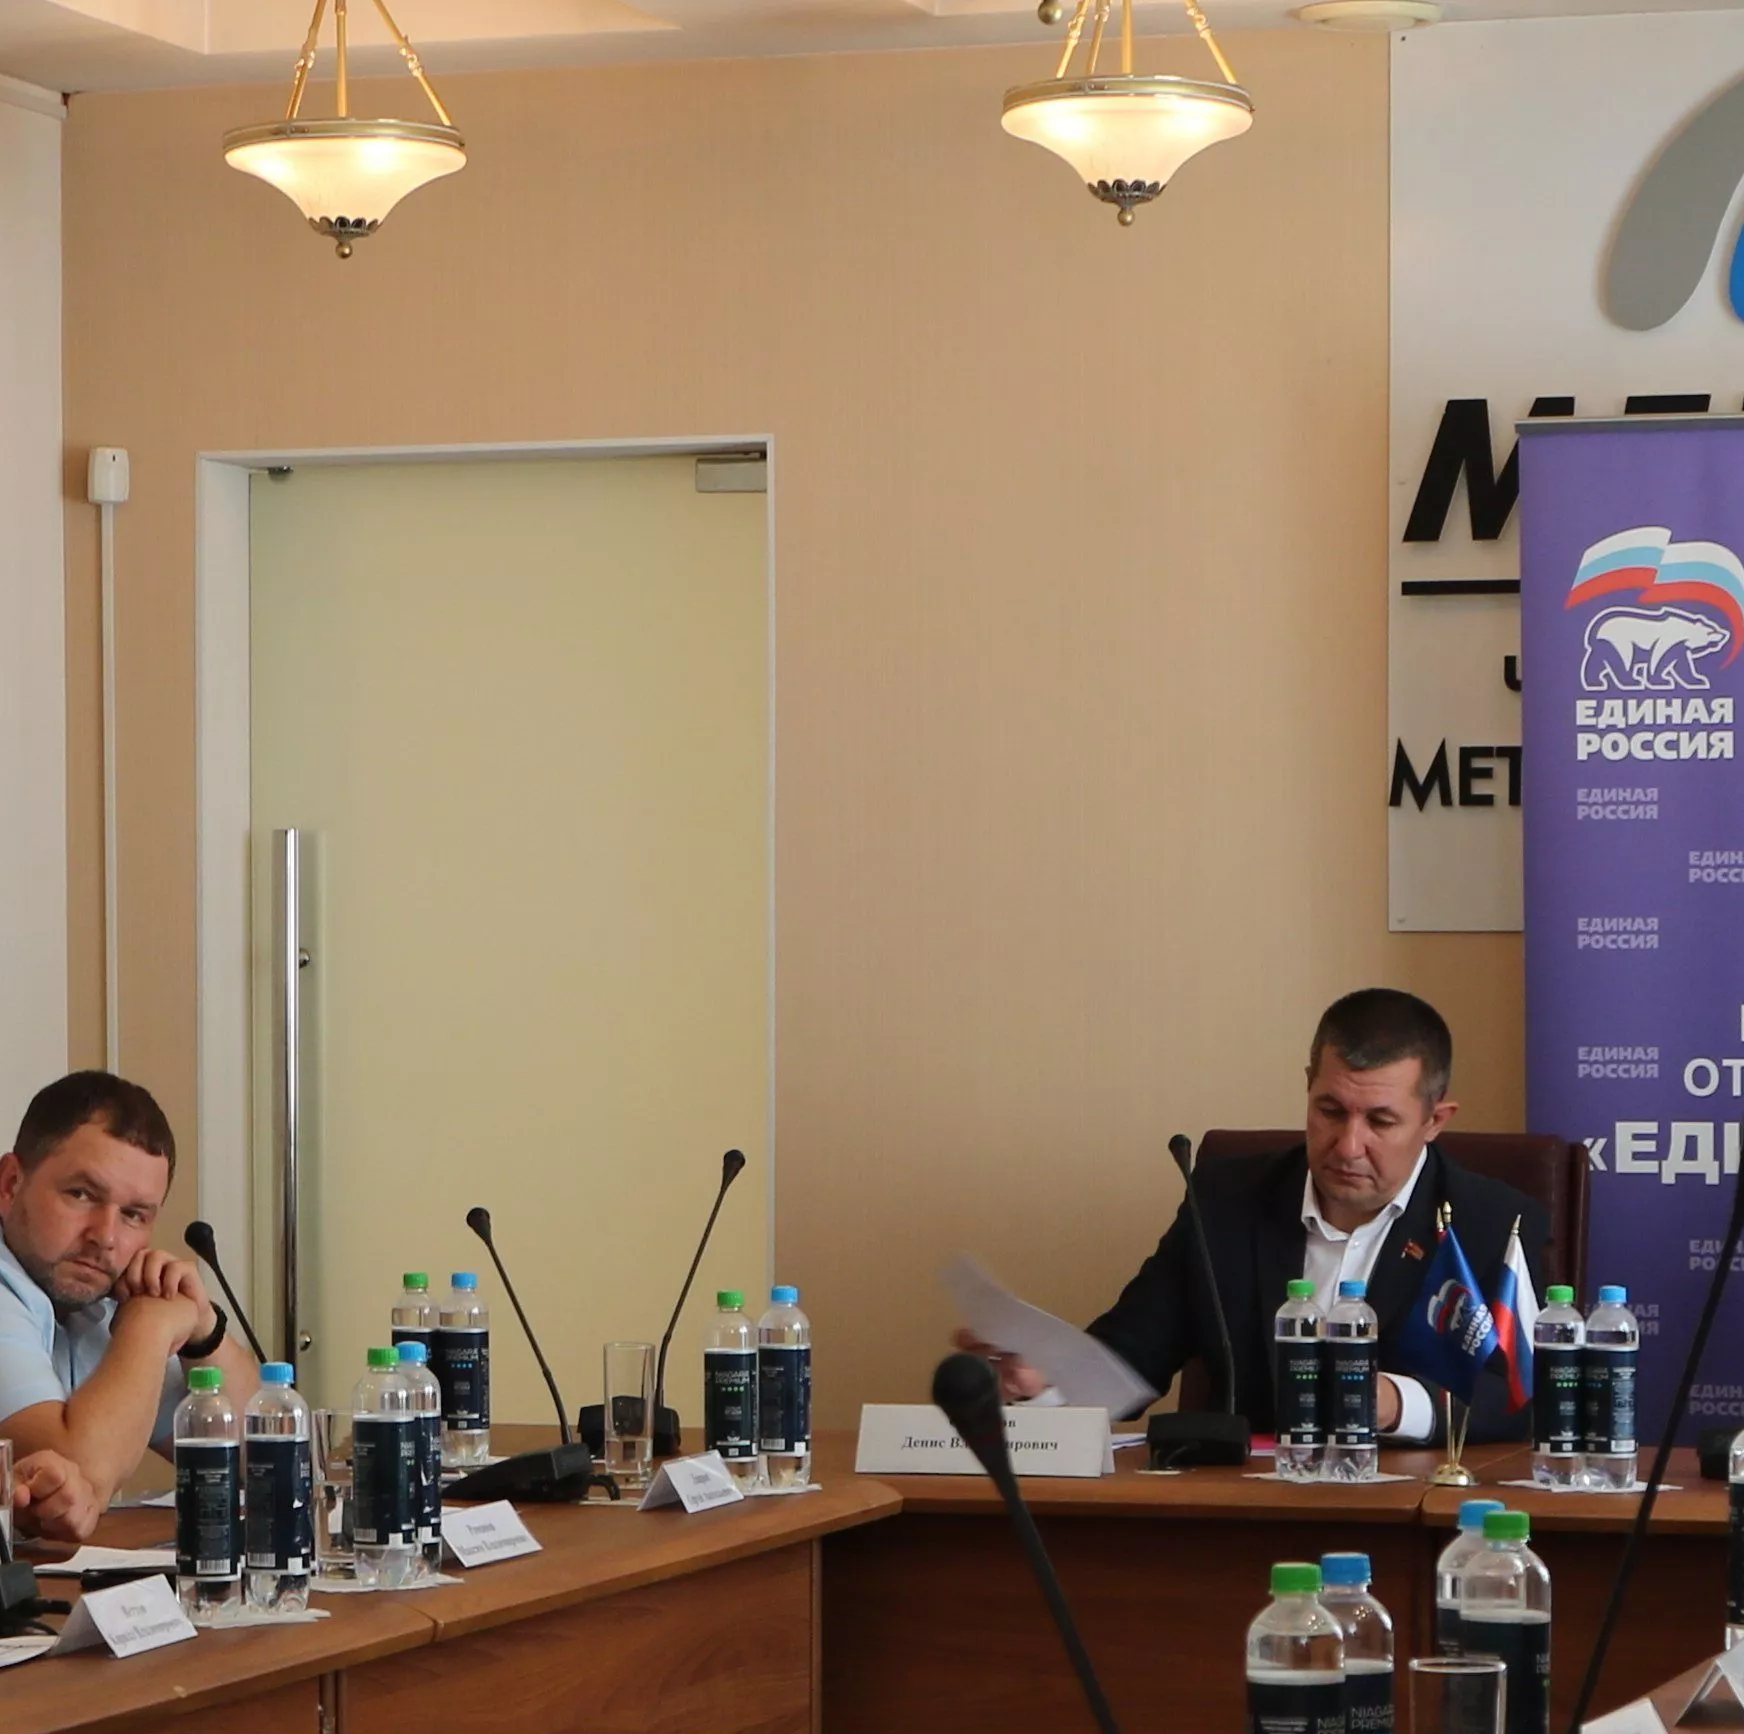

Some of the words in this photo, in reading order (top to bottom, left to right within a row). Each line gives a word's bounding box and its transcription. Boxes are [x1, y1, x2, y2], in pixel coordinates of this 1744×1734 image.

[1575, 697, 1735, 729] ЕДИНАЯ
[1576, 730, 1735, 761] РОССИЯ
[1577, 787, 1659, 804] ЕДИНАЯ
[1577, 804, 1659, 820] РОССИЯ
[1577, 917, 1659, 933] ЕДИНАЯ
[1577, 933, 1659, 949] РОССИЯ
[1578, 1046, 1659, 1062] ЕДИНАЯ
[1578, 1063, 1659, 1079] РОССИЯ
[902, 1436, 945, 1450] Денис
